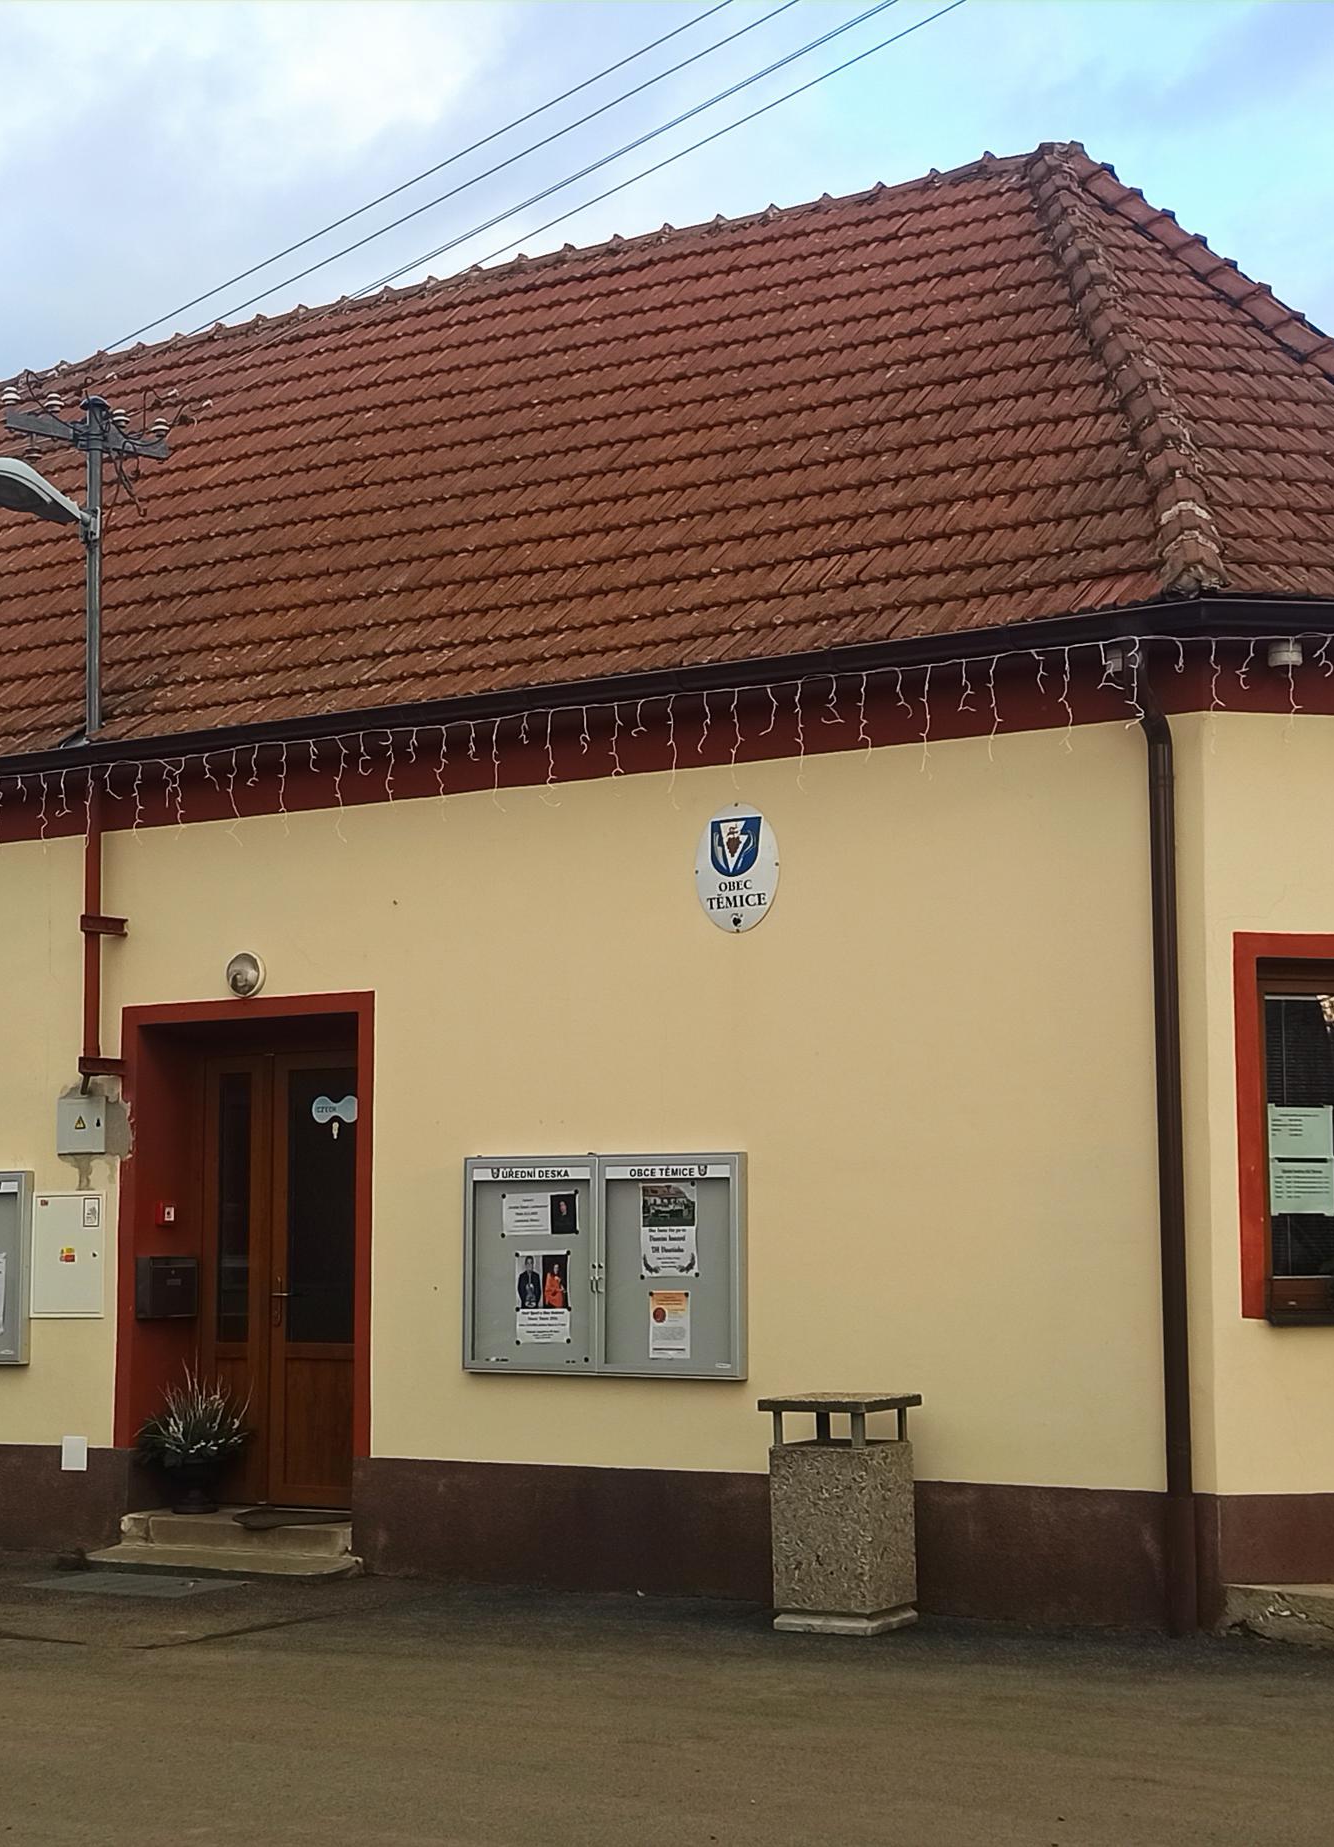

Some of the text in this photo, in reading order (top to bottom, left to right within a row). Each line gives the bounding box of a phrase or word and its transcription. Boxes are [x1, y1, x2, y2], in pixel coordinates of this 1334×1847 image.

[718, 880, 752, 892] OBEC
[707, 893, 767, 910] TĚMICE
[538, 1169, 570, 1178] DESKA
[629, 1168, 656, 1177] OBCE
